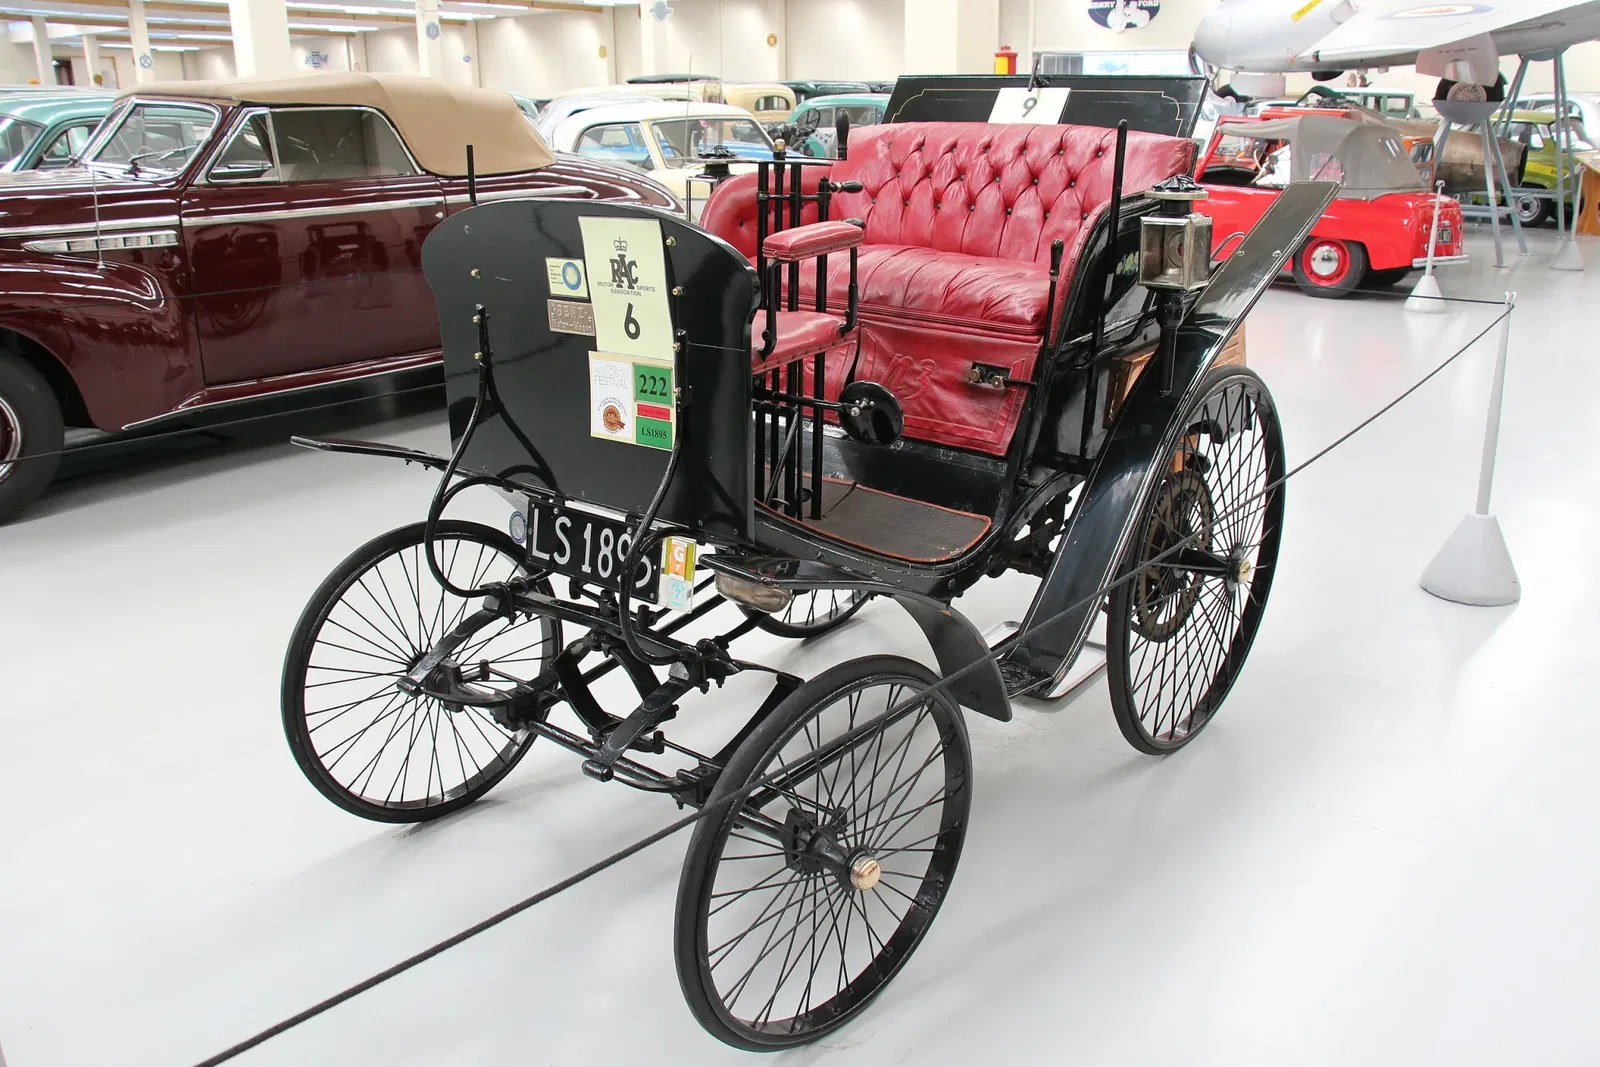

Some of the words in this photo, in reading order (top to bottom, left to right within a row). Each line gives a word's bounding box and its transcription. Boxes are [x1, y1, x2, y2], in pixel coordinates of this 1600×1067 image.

[609, 254, 639, 290] RAC
[610, 288, 642, 297] ASSOCIATION
[624, 302, 641, 340] 6
[594, 374, 629, 390] FESTIVAL
[639, 374, 667, 397] 222
[641, 427, 667, 440] LS1895
[531, 508, 572, 565] LS
[673, 545, 685, 563] G
